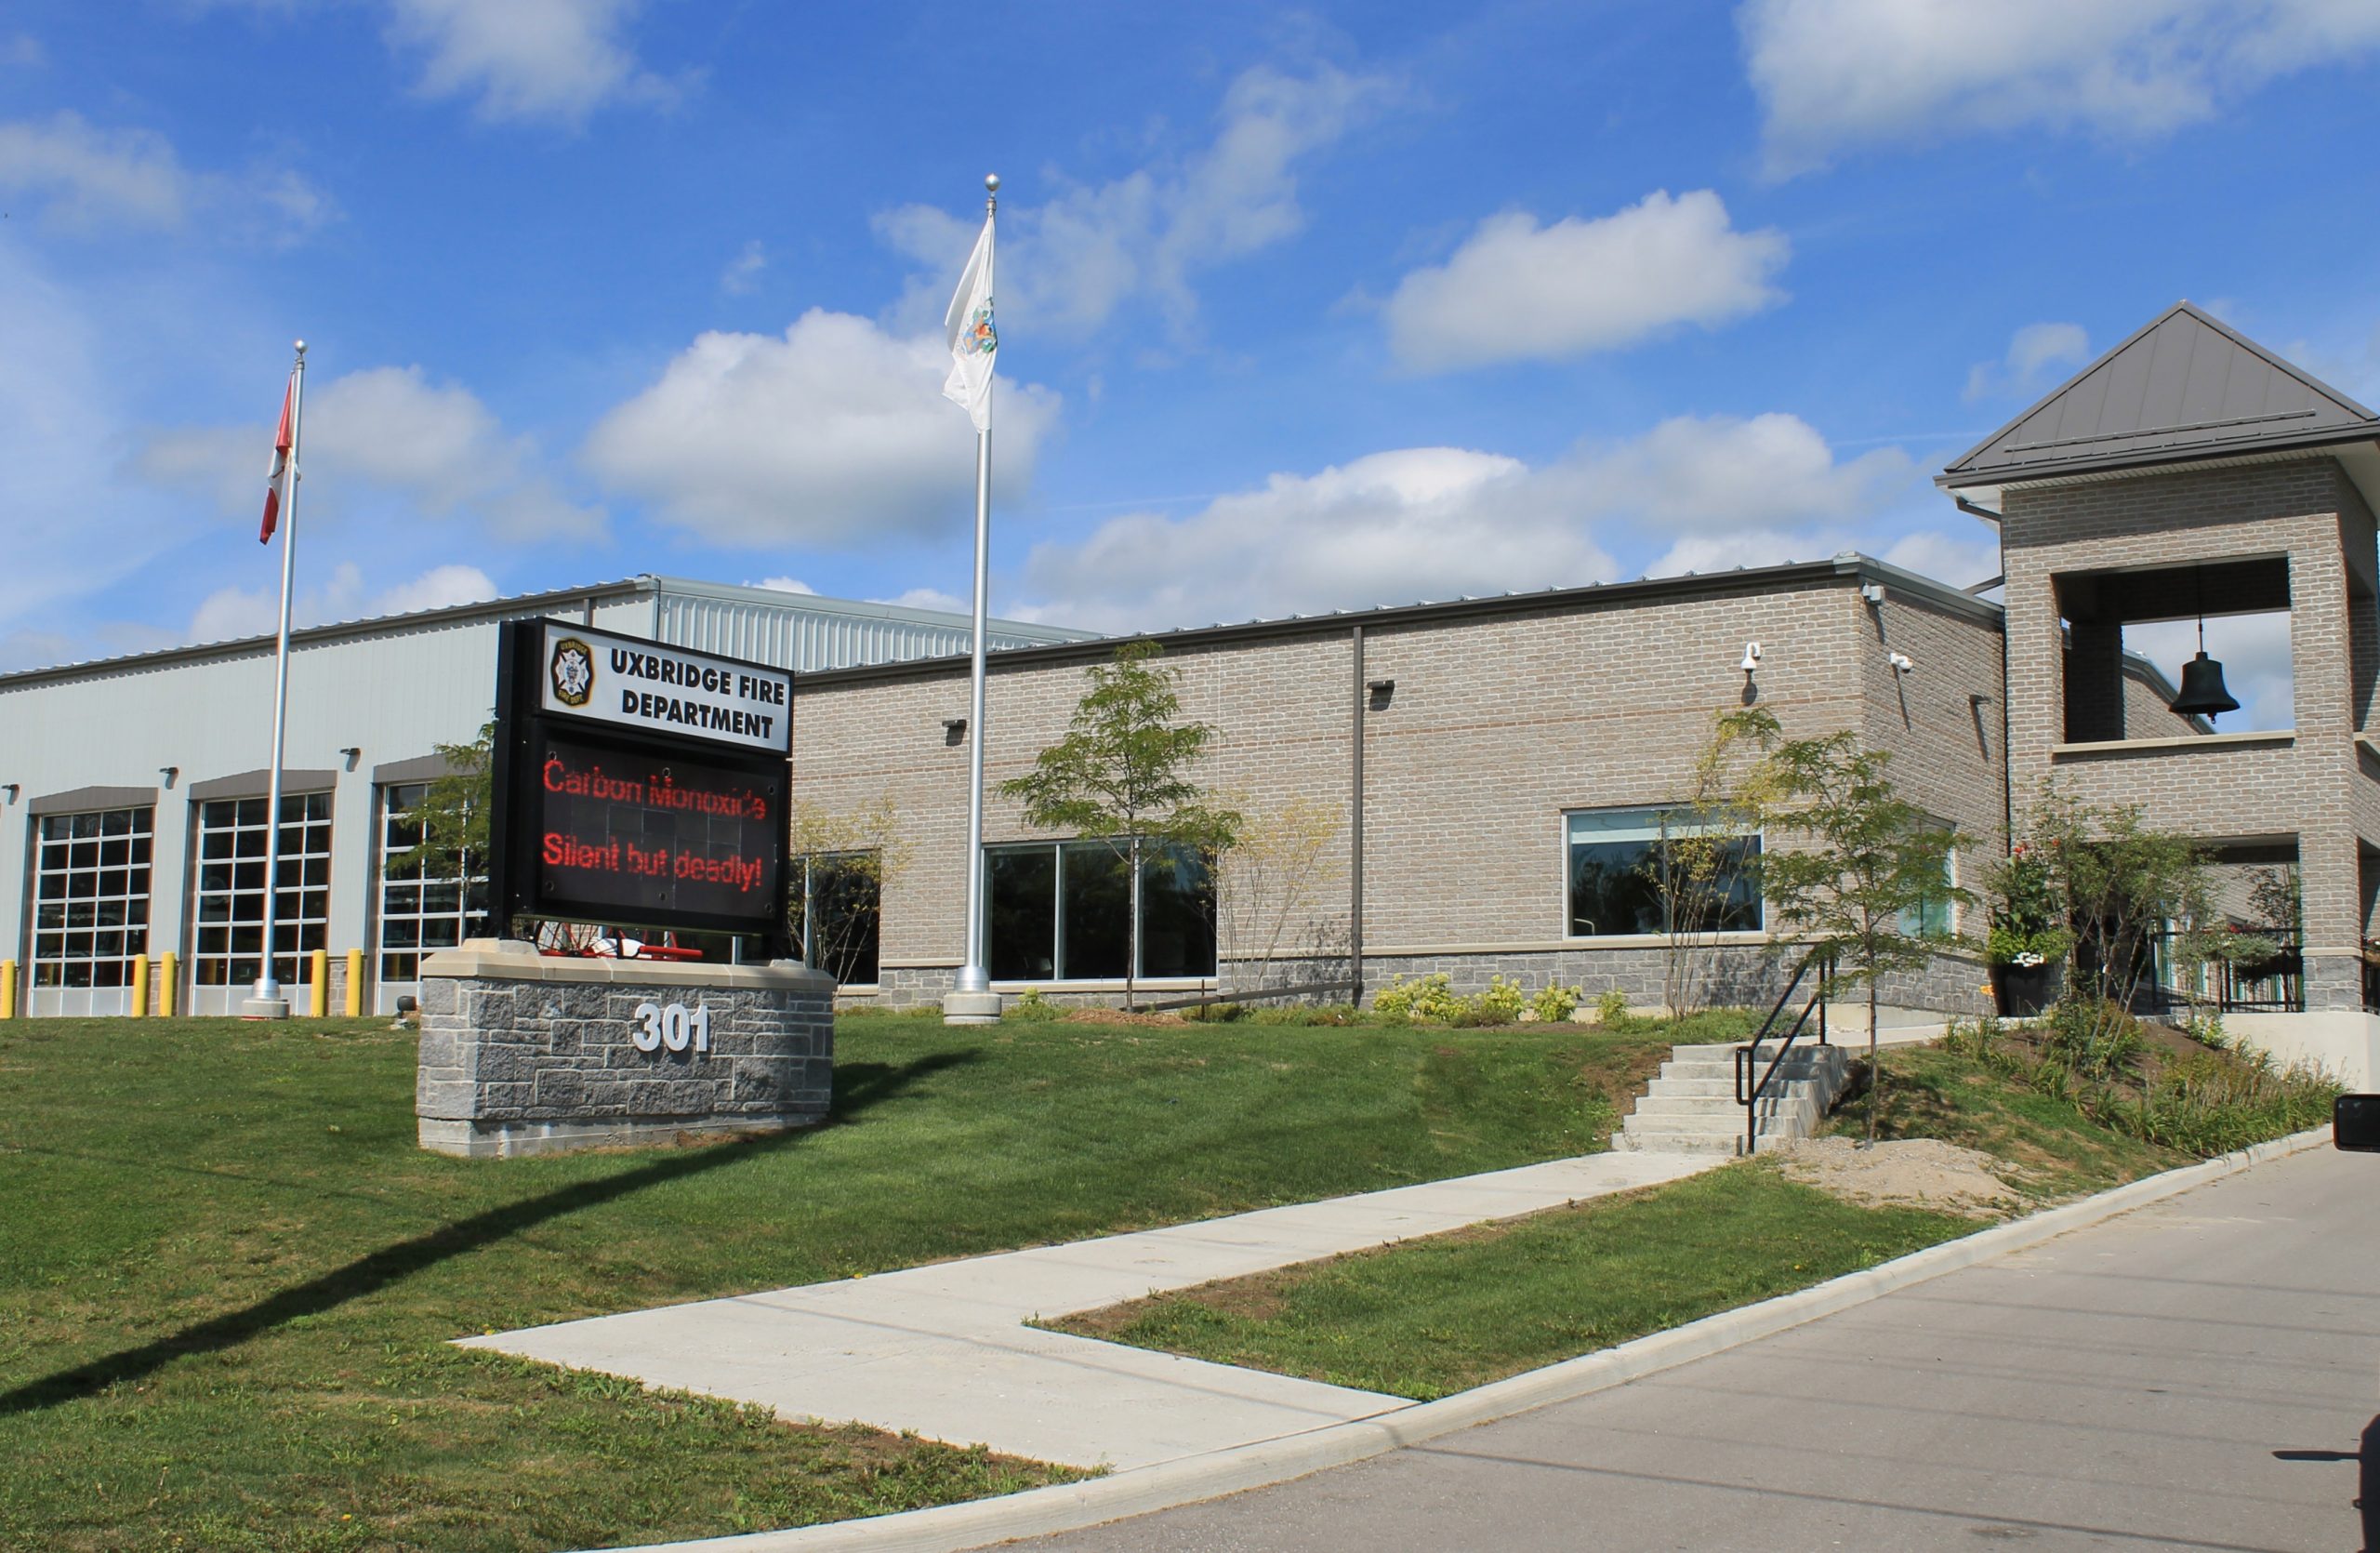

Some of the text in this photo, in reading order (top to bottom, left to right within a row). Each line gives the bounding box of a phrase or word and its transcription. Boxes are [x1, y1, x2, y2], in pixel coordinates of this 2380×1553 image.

[611, 648, 785, 706] UXBRIDGE FIRE
[622, 689, 774, 739] DEPARTMENT
[543, 760, 642, 803] Carbon
[543, 833, 762, 892] Silent but deadly!
[632, 1003, 707, 1052] 301
